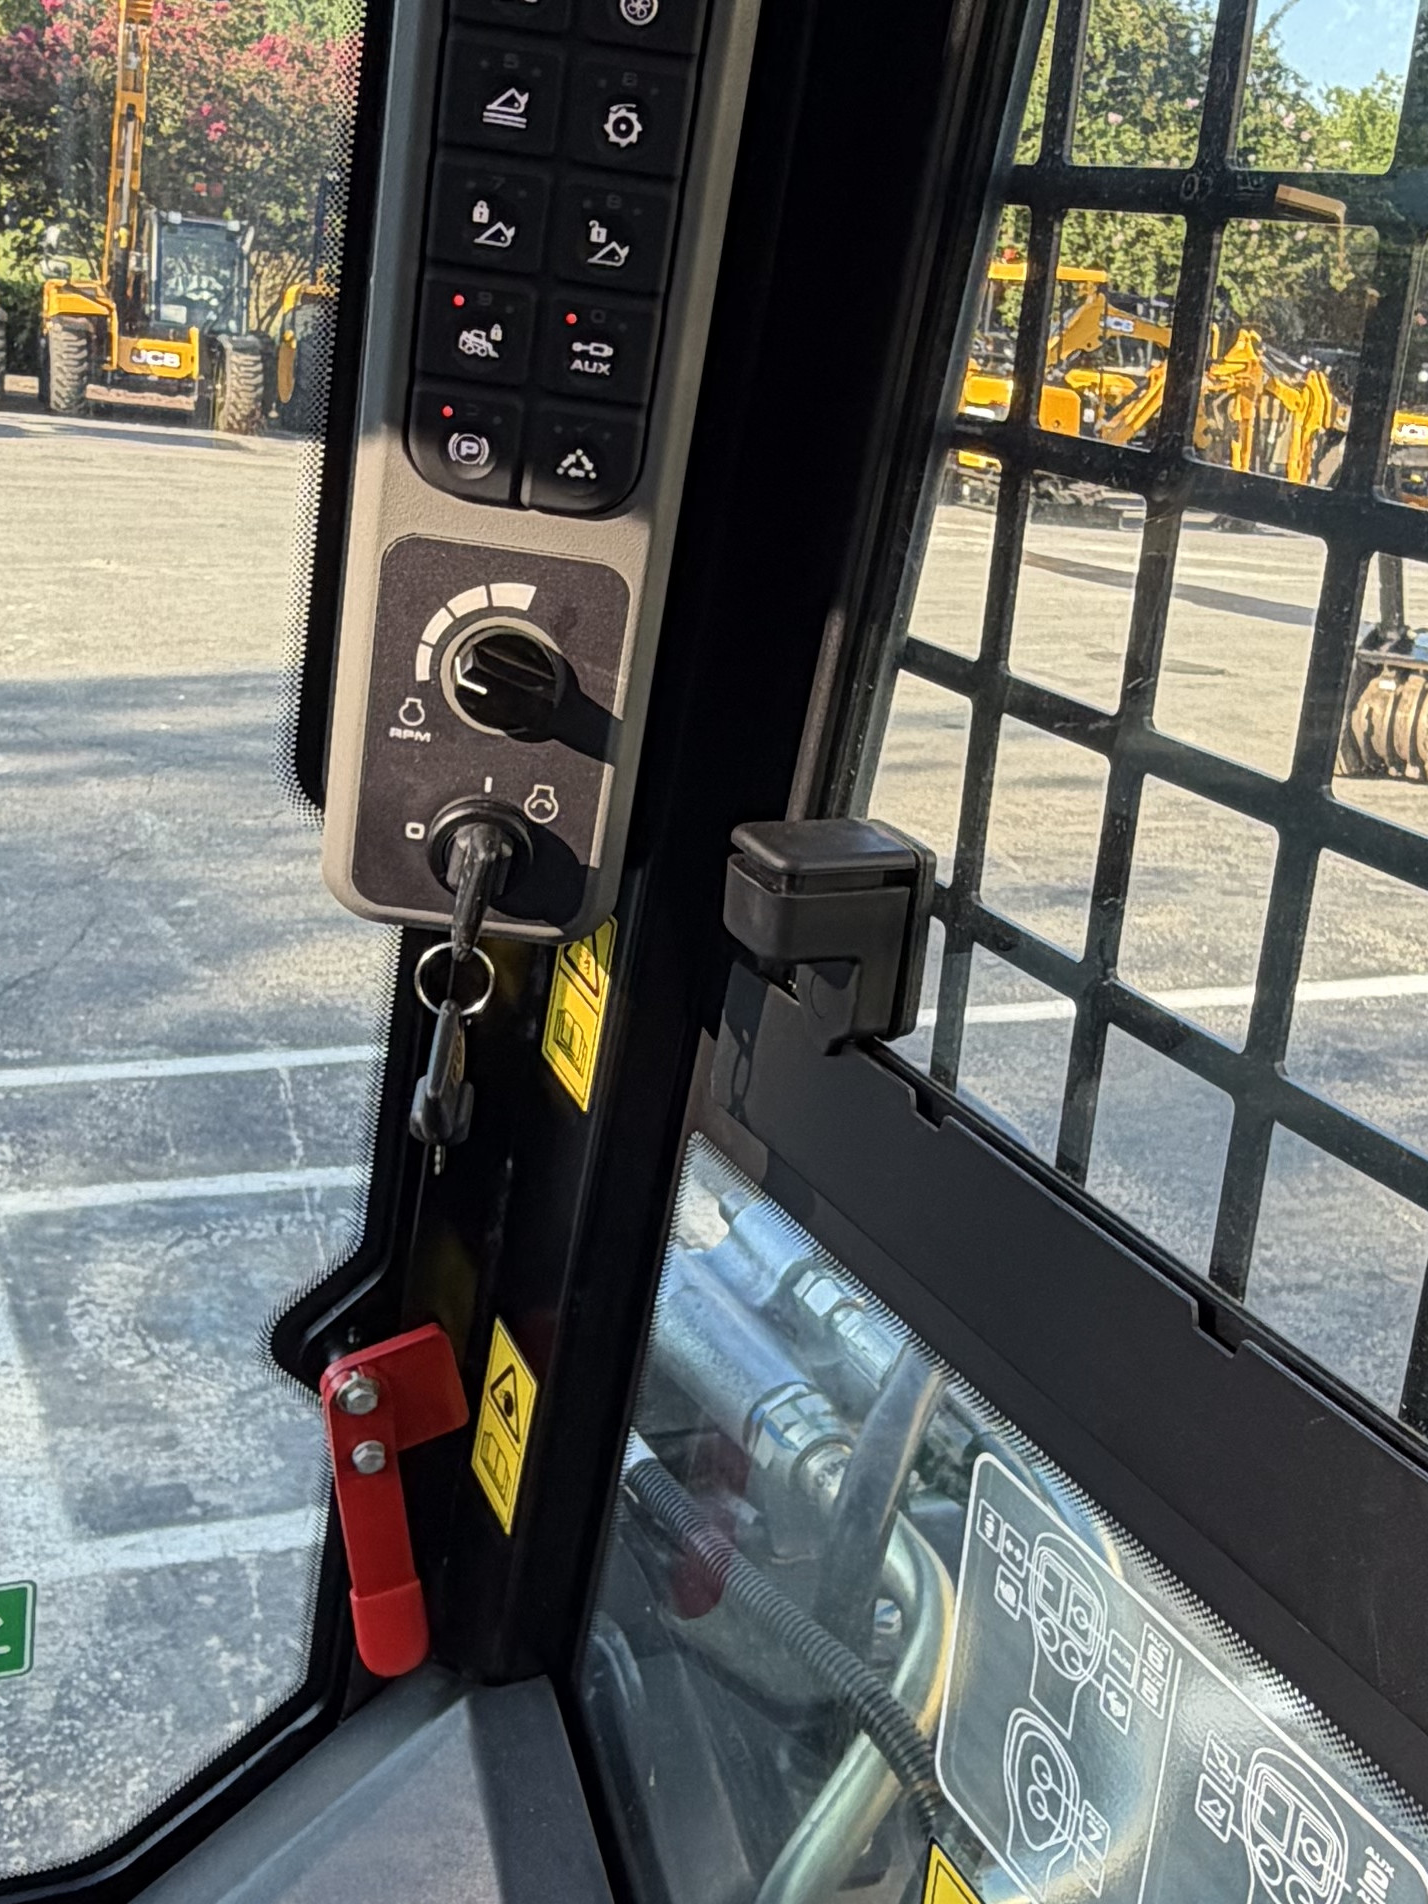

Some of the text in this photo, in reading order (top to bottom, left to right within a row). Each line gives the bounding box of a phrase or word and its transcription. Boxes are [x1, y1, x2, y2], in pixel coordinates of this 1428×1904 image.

[132, 349, 180, 368] JCB
[570, 359, 611, 376] AUX
[389, 726, 431, 743] RPM
[1364, 1845, 1395, 1880] AUX
[1363, 1859, 1389, 1900] 2
